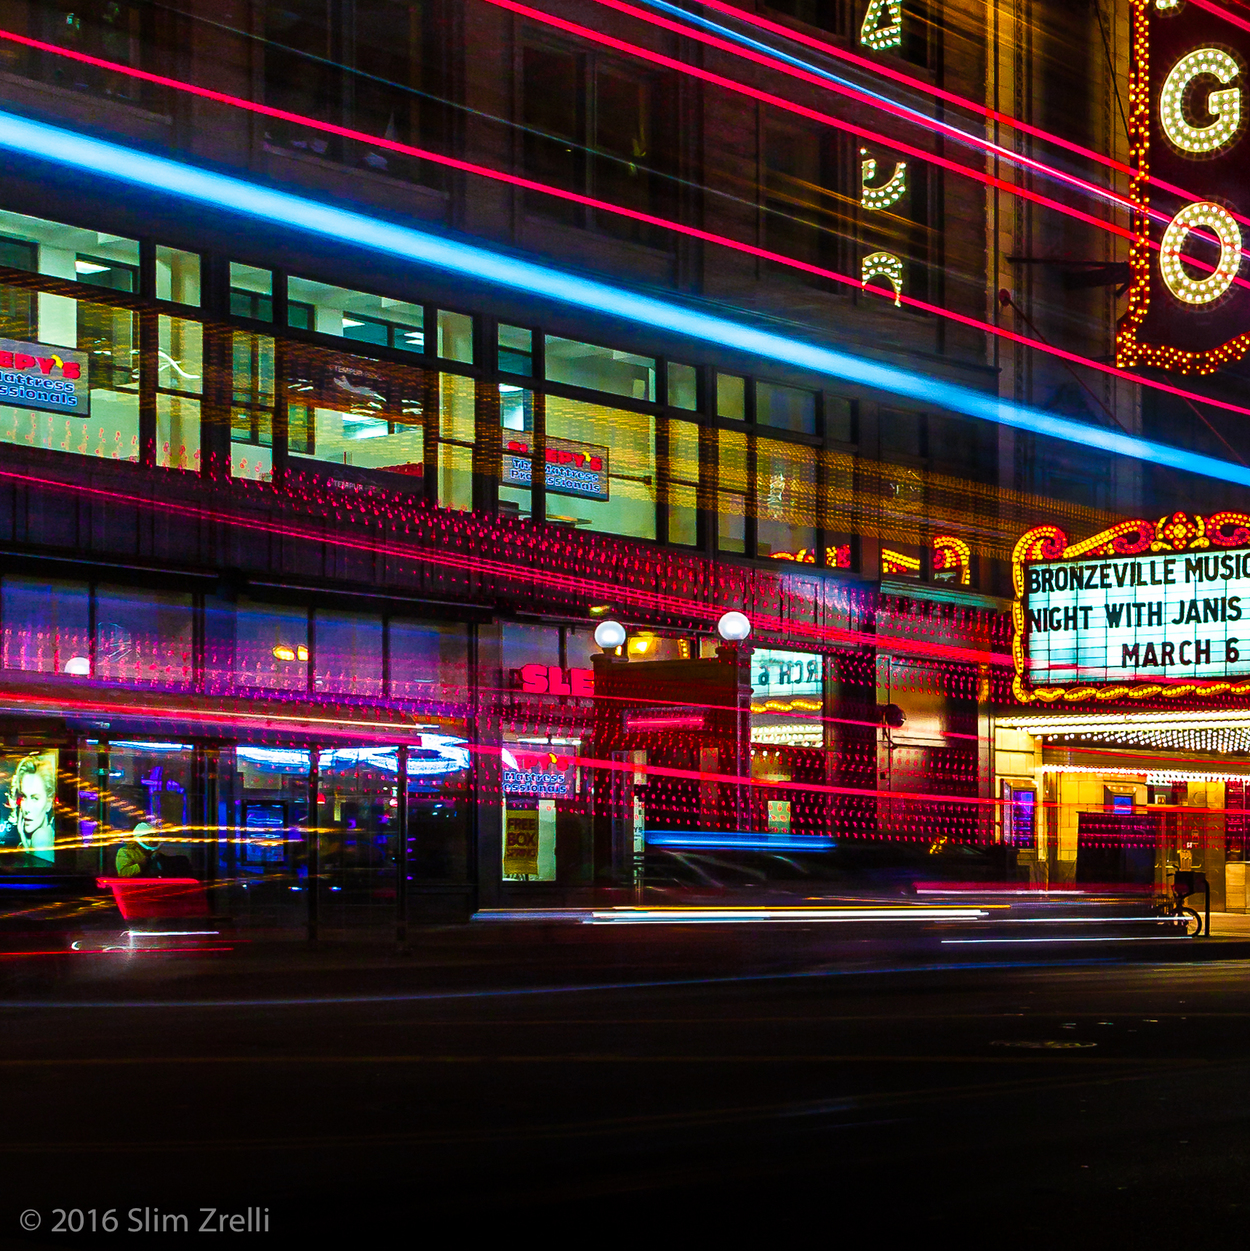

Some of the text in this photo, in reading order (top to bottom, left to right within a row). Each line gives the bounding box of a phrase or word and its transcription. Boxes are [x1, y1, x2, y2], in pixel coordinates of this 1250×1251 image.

[0, 370, 75, 393] attress
[1028, 558, 1176, 594] BRONZEVILLE
[1028, 606, 1093, 633] NIGHT
[1105, 600, 1163, 629] WITH
[1171, 595, 1242, 625] JANIS
[1121, 636, 1241, 668] MARCH 6
[507, 832, 537, 846] BOX
